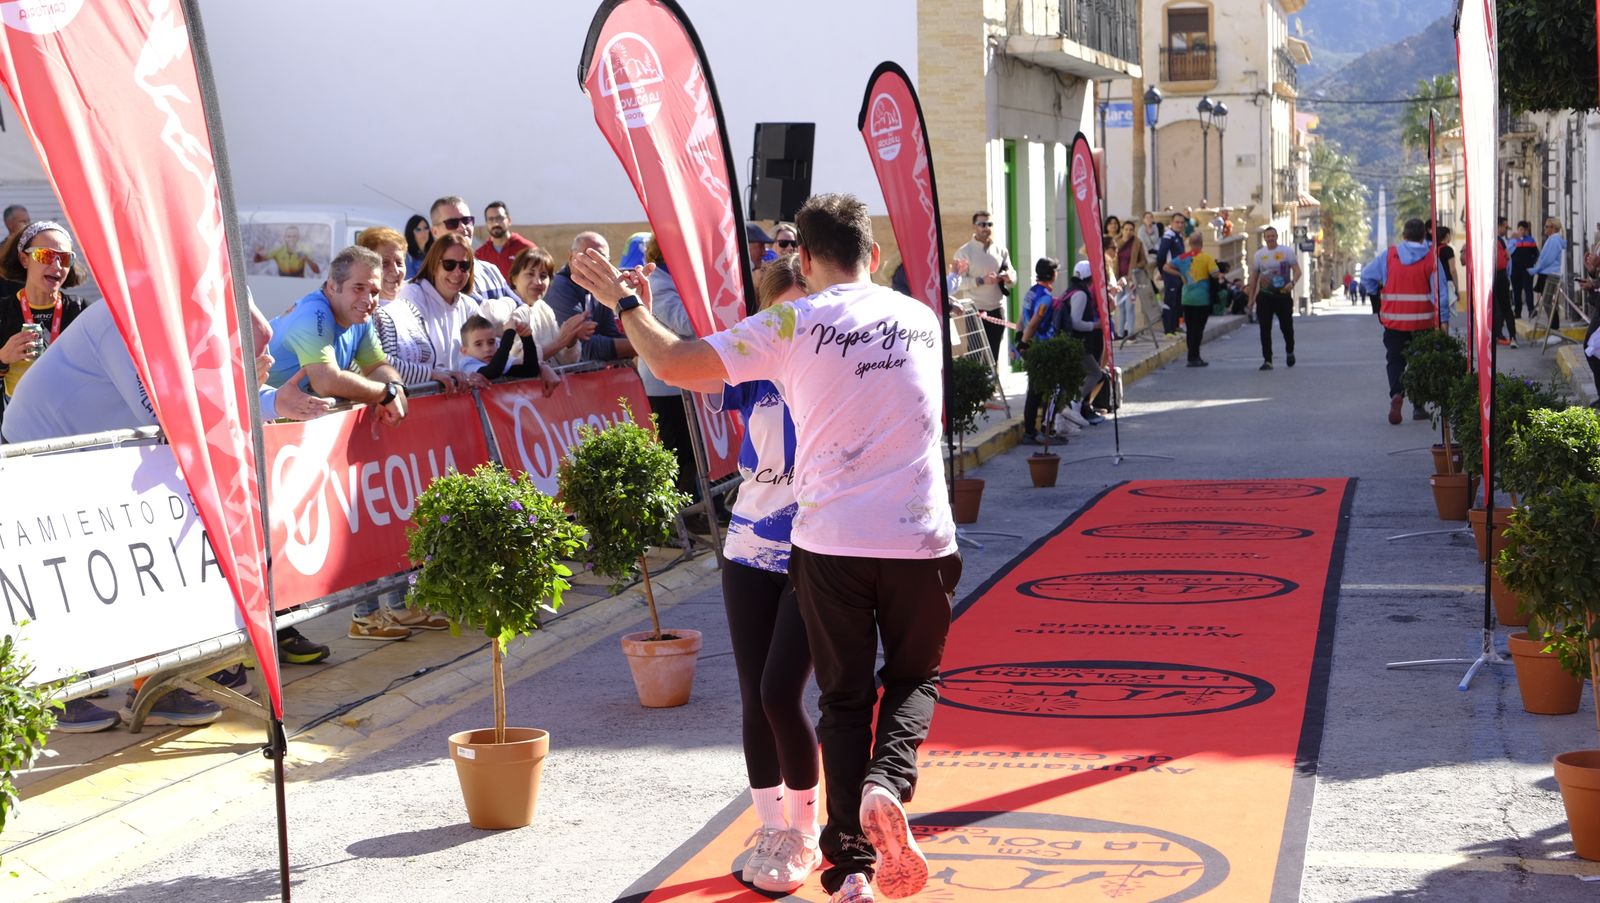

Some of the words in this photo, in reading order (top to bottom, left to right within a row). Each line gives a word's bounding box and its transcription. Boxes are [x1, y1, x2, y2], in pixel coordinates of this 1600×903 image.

[811, 323, 873, 358] Pepe
[876, 321, 935, 352] Yepes
[855, 354, 906, 379] speaker
[1014, 629, 1243, 638] Ayuntamiento
[1181, 674, 1231, 682] LA
[928, 750, 1106, 762] Cantoria
[1122, 754, 1173, 764] de
[919, 760, 1195, 775] Ayuntamient
[909, 827, 989, 835] Canto
[1103, 840, 1170, 852] LA
